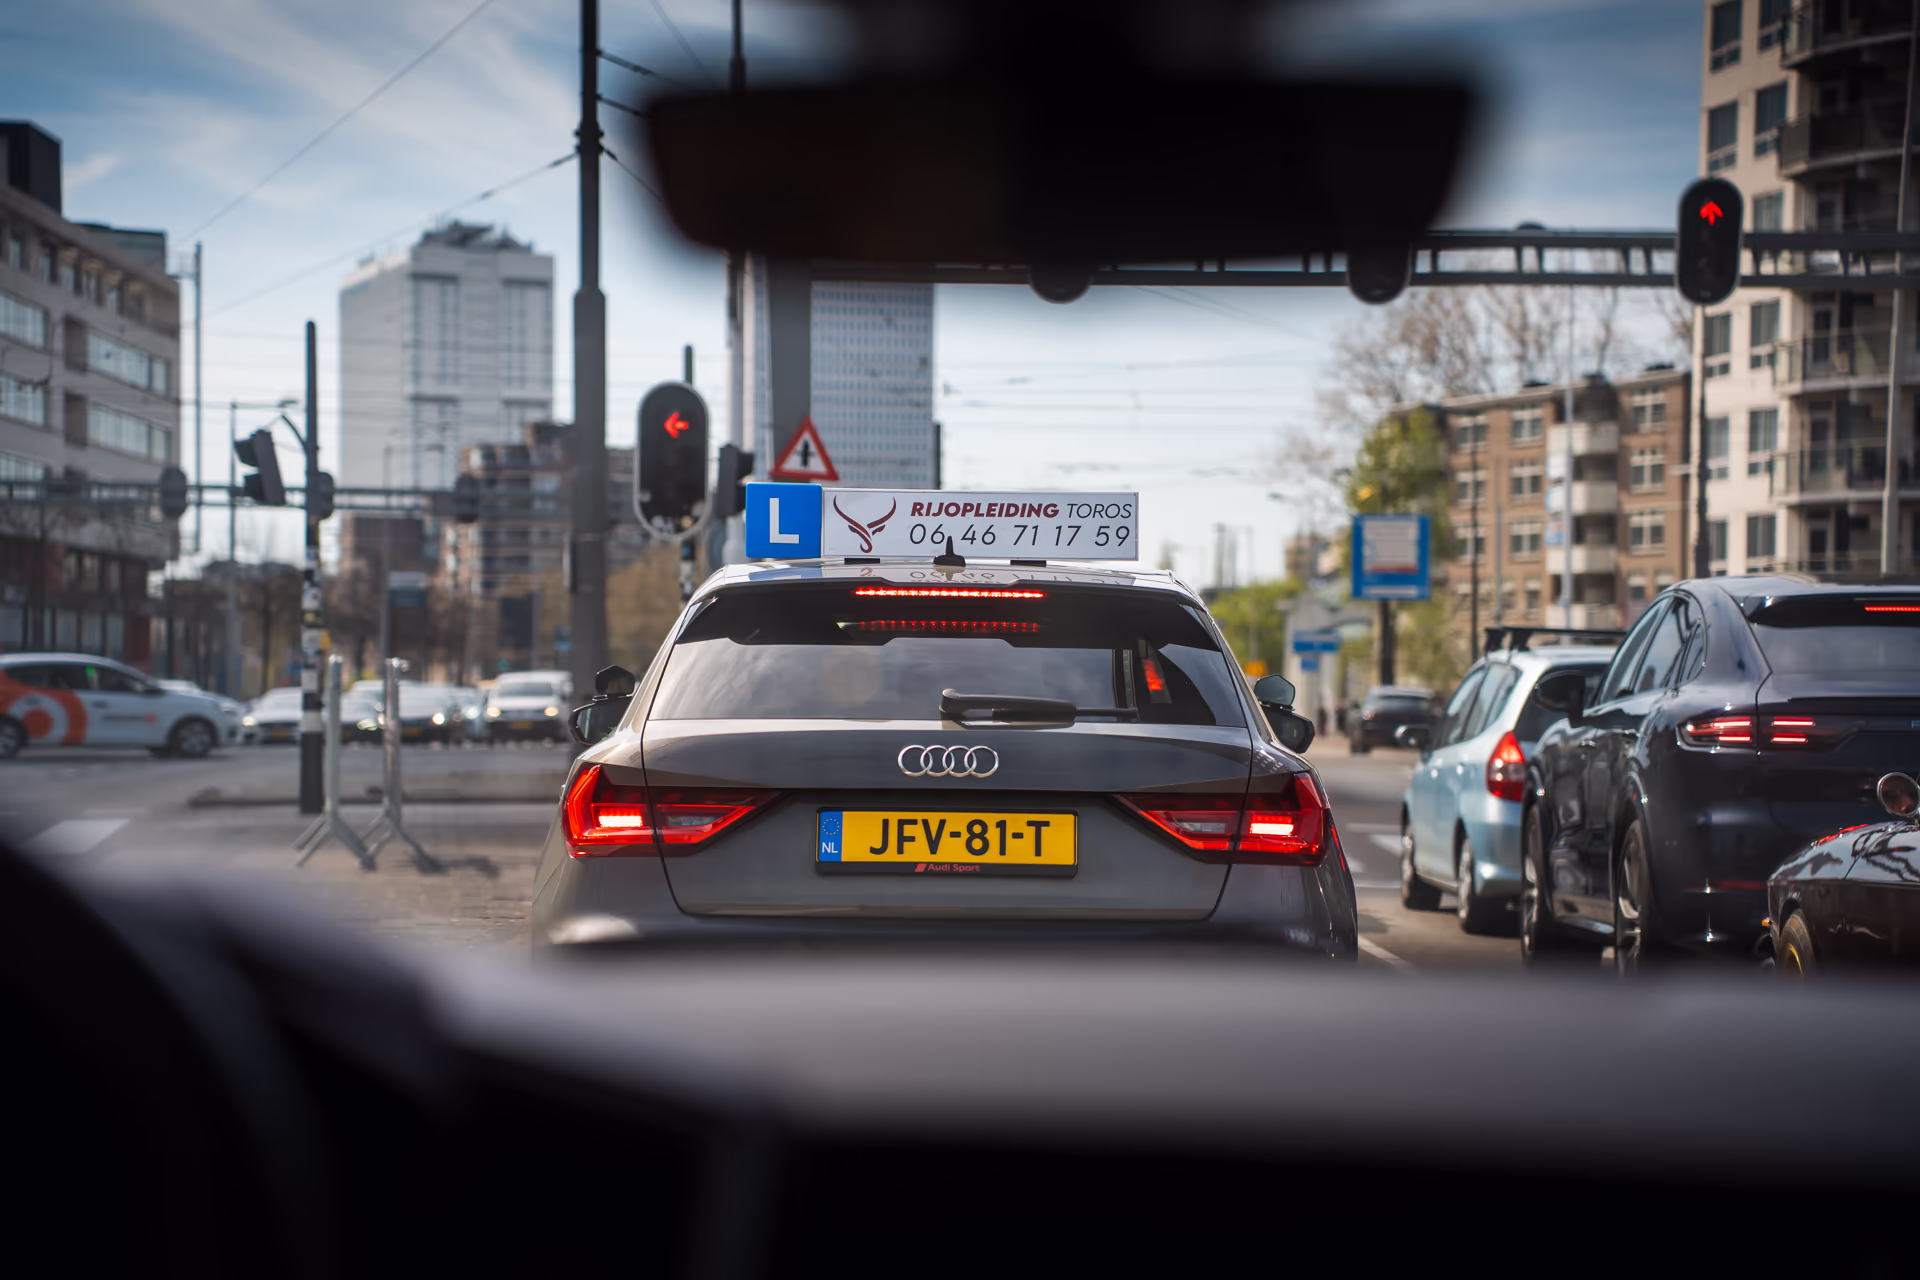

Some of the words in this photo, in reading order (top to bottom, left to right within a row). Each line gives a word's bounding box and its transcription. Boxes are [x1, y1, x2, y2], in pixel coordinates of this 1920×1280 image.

[911, 502, 1060, 518] RIJOPLEIDING
[1067, 503, 1132, 519] TOROS
[769, 498, 799, 544] L
[910, 523, 945, 545] 06
[960, 524, 996, 545] 46
[1013, 525, 1039, 546] 71
[1055, 525, 1082, 546] 17
[1094, 525, 1130, 547] 59
[821, 841, 839, 854] NL
[869, 818, 1050, 857] JFV-81-T
[927, 863, 951, 872] Audi
[952, 863, 981, 873] Sport
